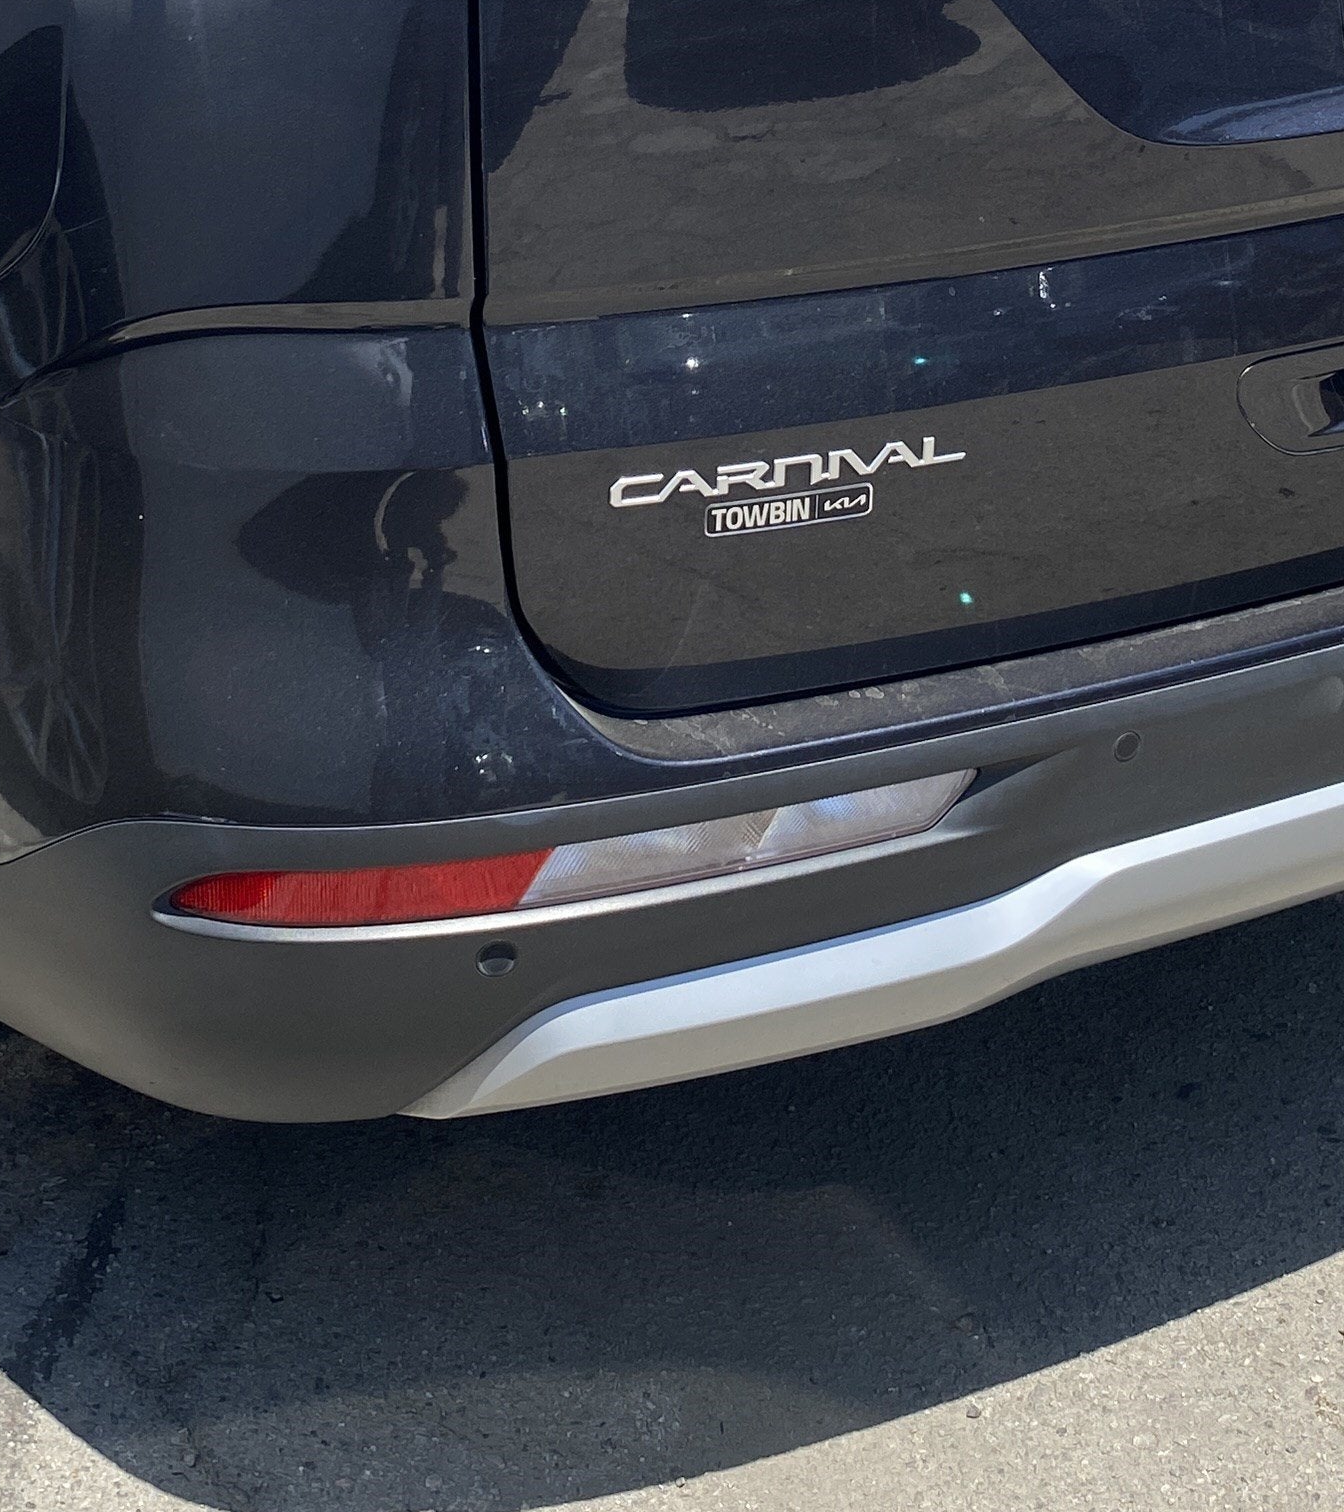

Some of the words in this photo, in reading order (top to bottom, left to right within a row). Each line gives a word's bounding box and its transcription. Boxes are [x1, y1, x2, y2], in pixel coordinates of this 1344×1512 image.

[609, 436, 967, 508] CARNIVAL
[711, 497, 810, 532] TOWBIN
[823, 493, 868, 512] KIA
